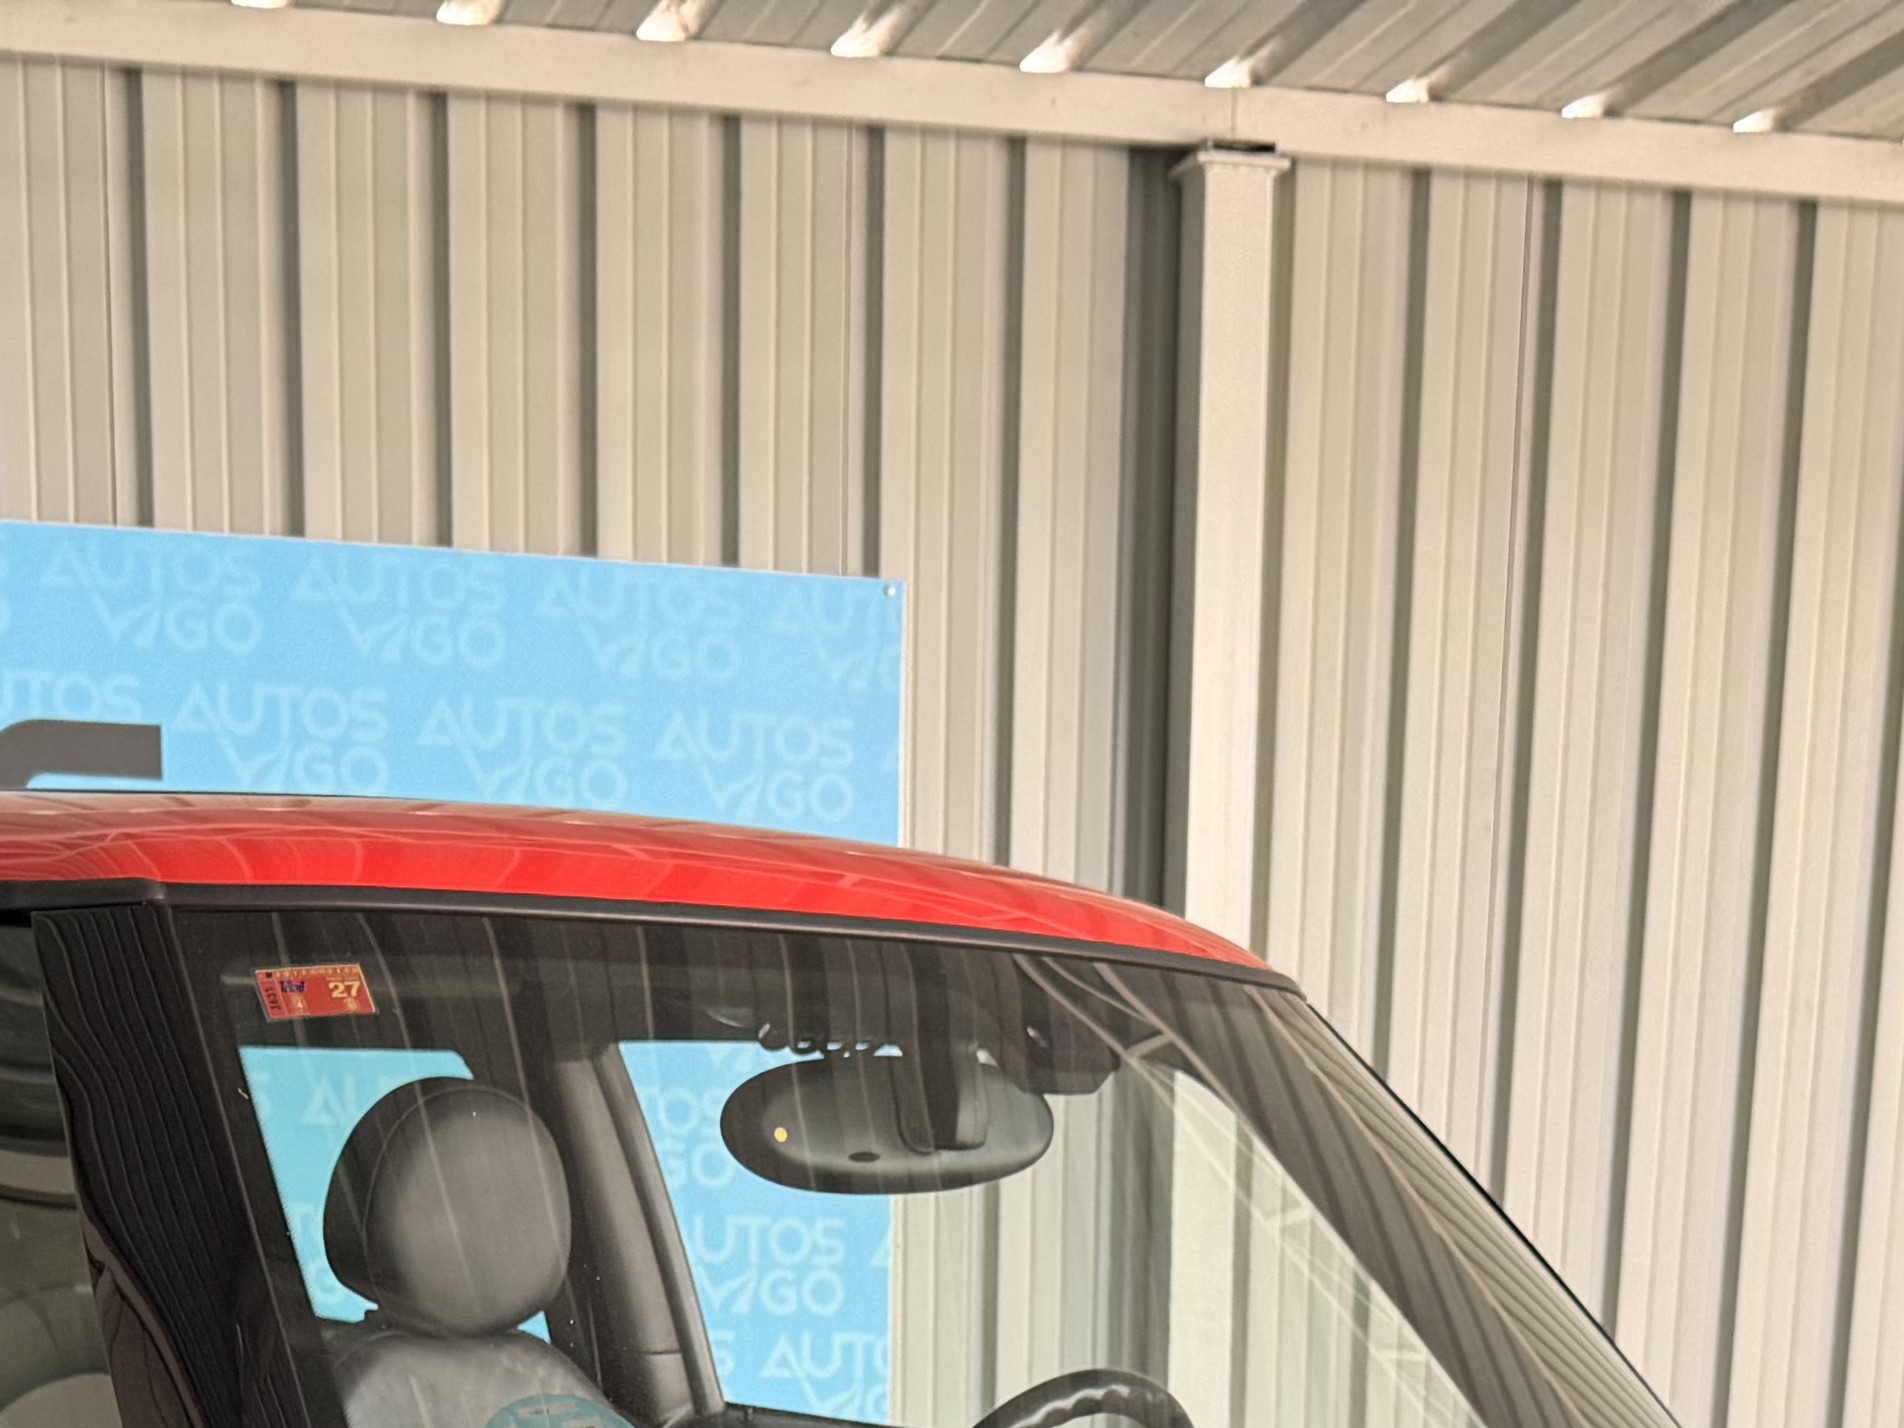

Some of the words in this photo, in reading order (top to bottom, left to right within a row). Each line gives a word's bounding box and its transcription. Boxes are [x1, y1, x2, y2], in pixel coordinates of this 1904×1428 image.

[41, 533, 262, 600] AUTOS
[294, 552, 506, 614] AUTOS
[90, 590, 264, 655] VIGO
[534, 569, 741, 630] AUTOS
[336, 606, 507, 667] VIGO
[578, 620, 743, 683] VIGO
[171, 680, 389, 742] AUTOS
[418, 695, 627, 755] AUTOS
[654, 708, 856, 768] AUTOS
[700, 762, 853, 823] VIGO
[328, 980, 361, 998] 27
[695, 1213, 846, 1266] UTOS
